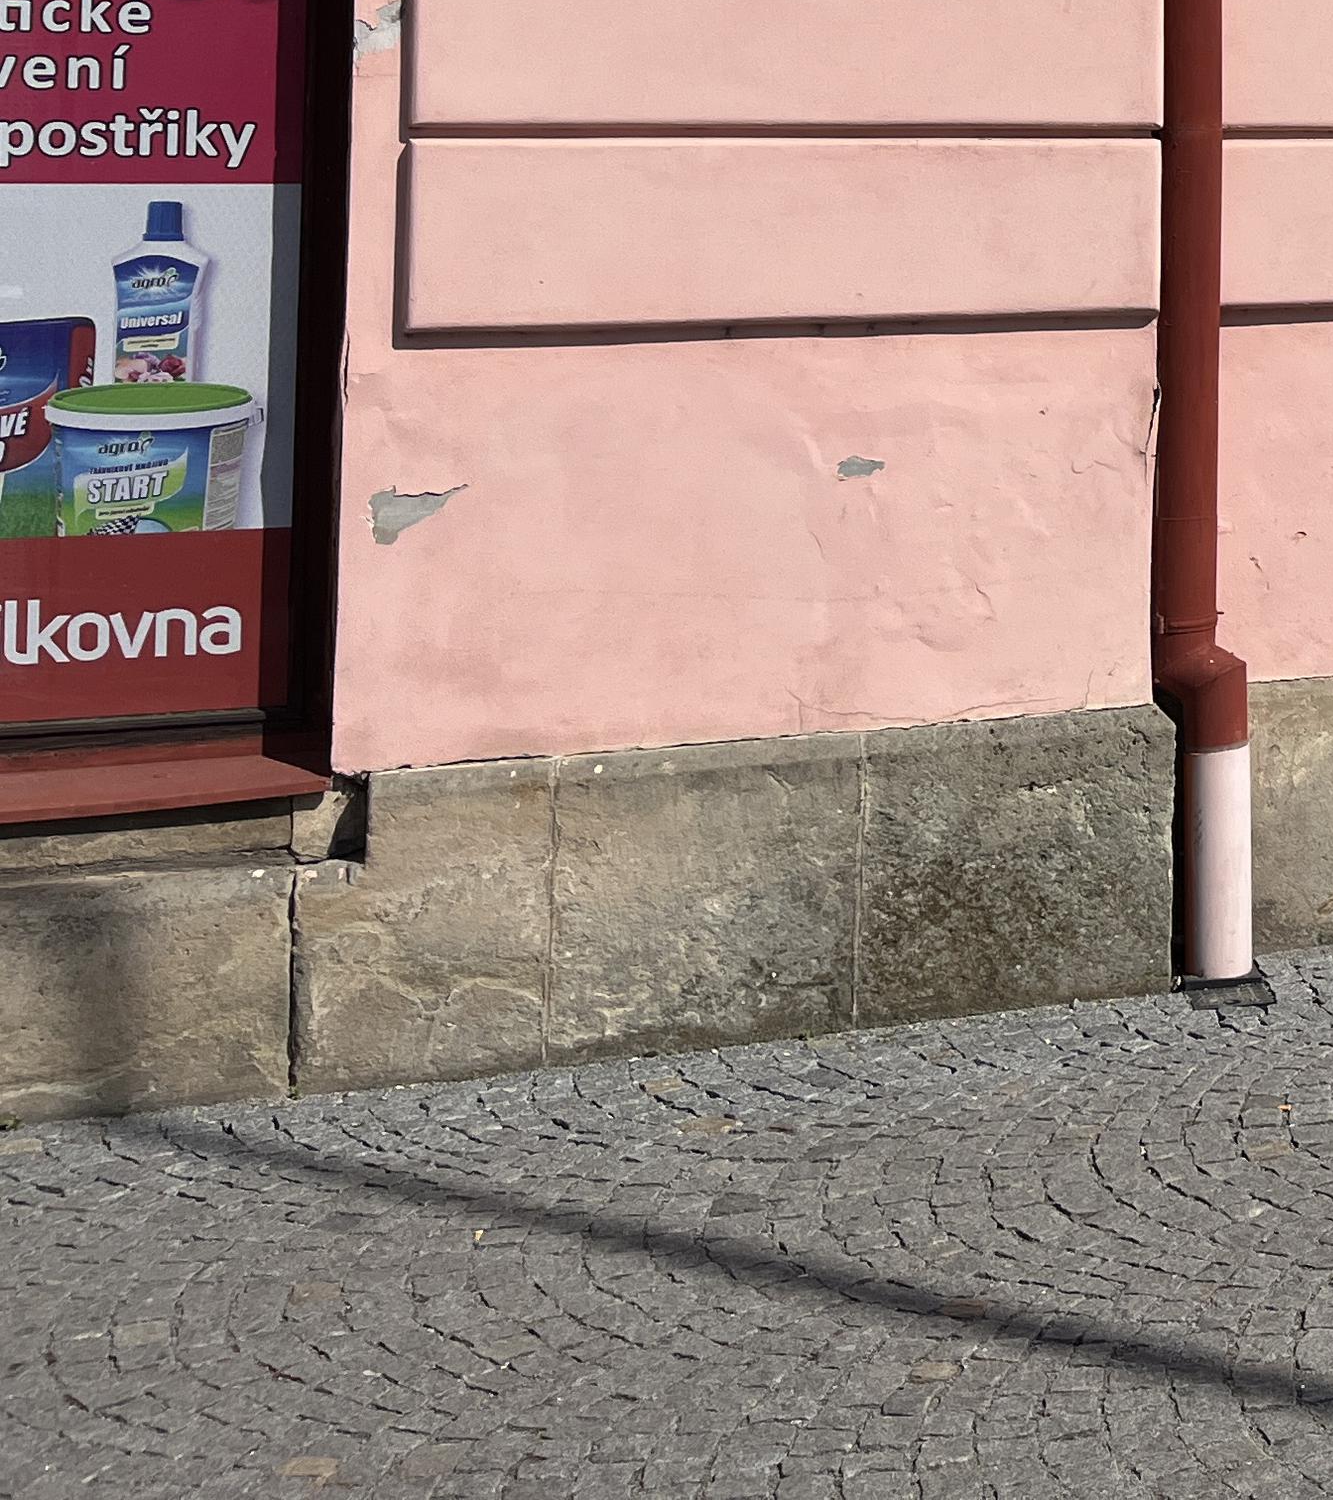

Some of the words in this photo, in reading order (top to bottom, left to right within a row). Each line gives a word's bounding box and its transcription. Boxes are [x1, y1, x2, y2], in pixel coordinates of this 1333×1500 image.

[0, 107, 256, 169] postřiky
[120, 311, 184, 329] Universal
[87, 470, 169, 504] START
[0, 599, 242, 665] lkovna
